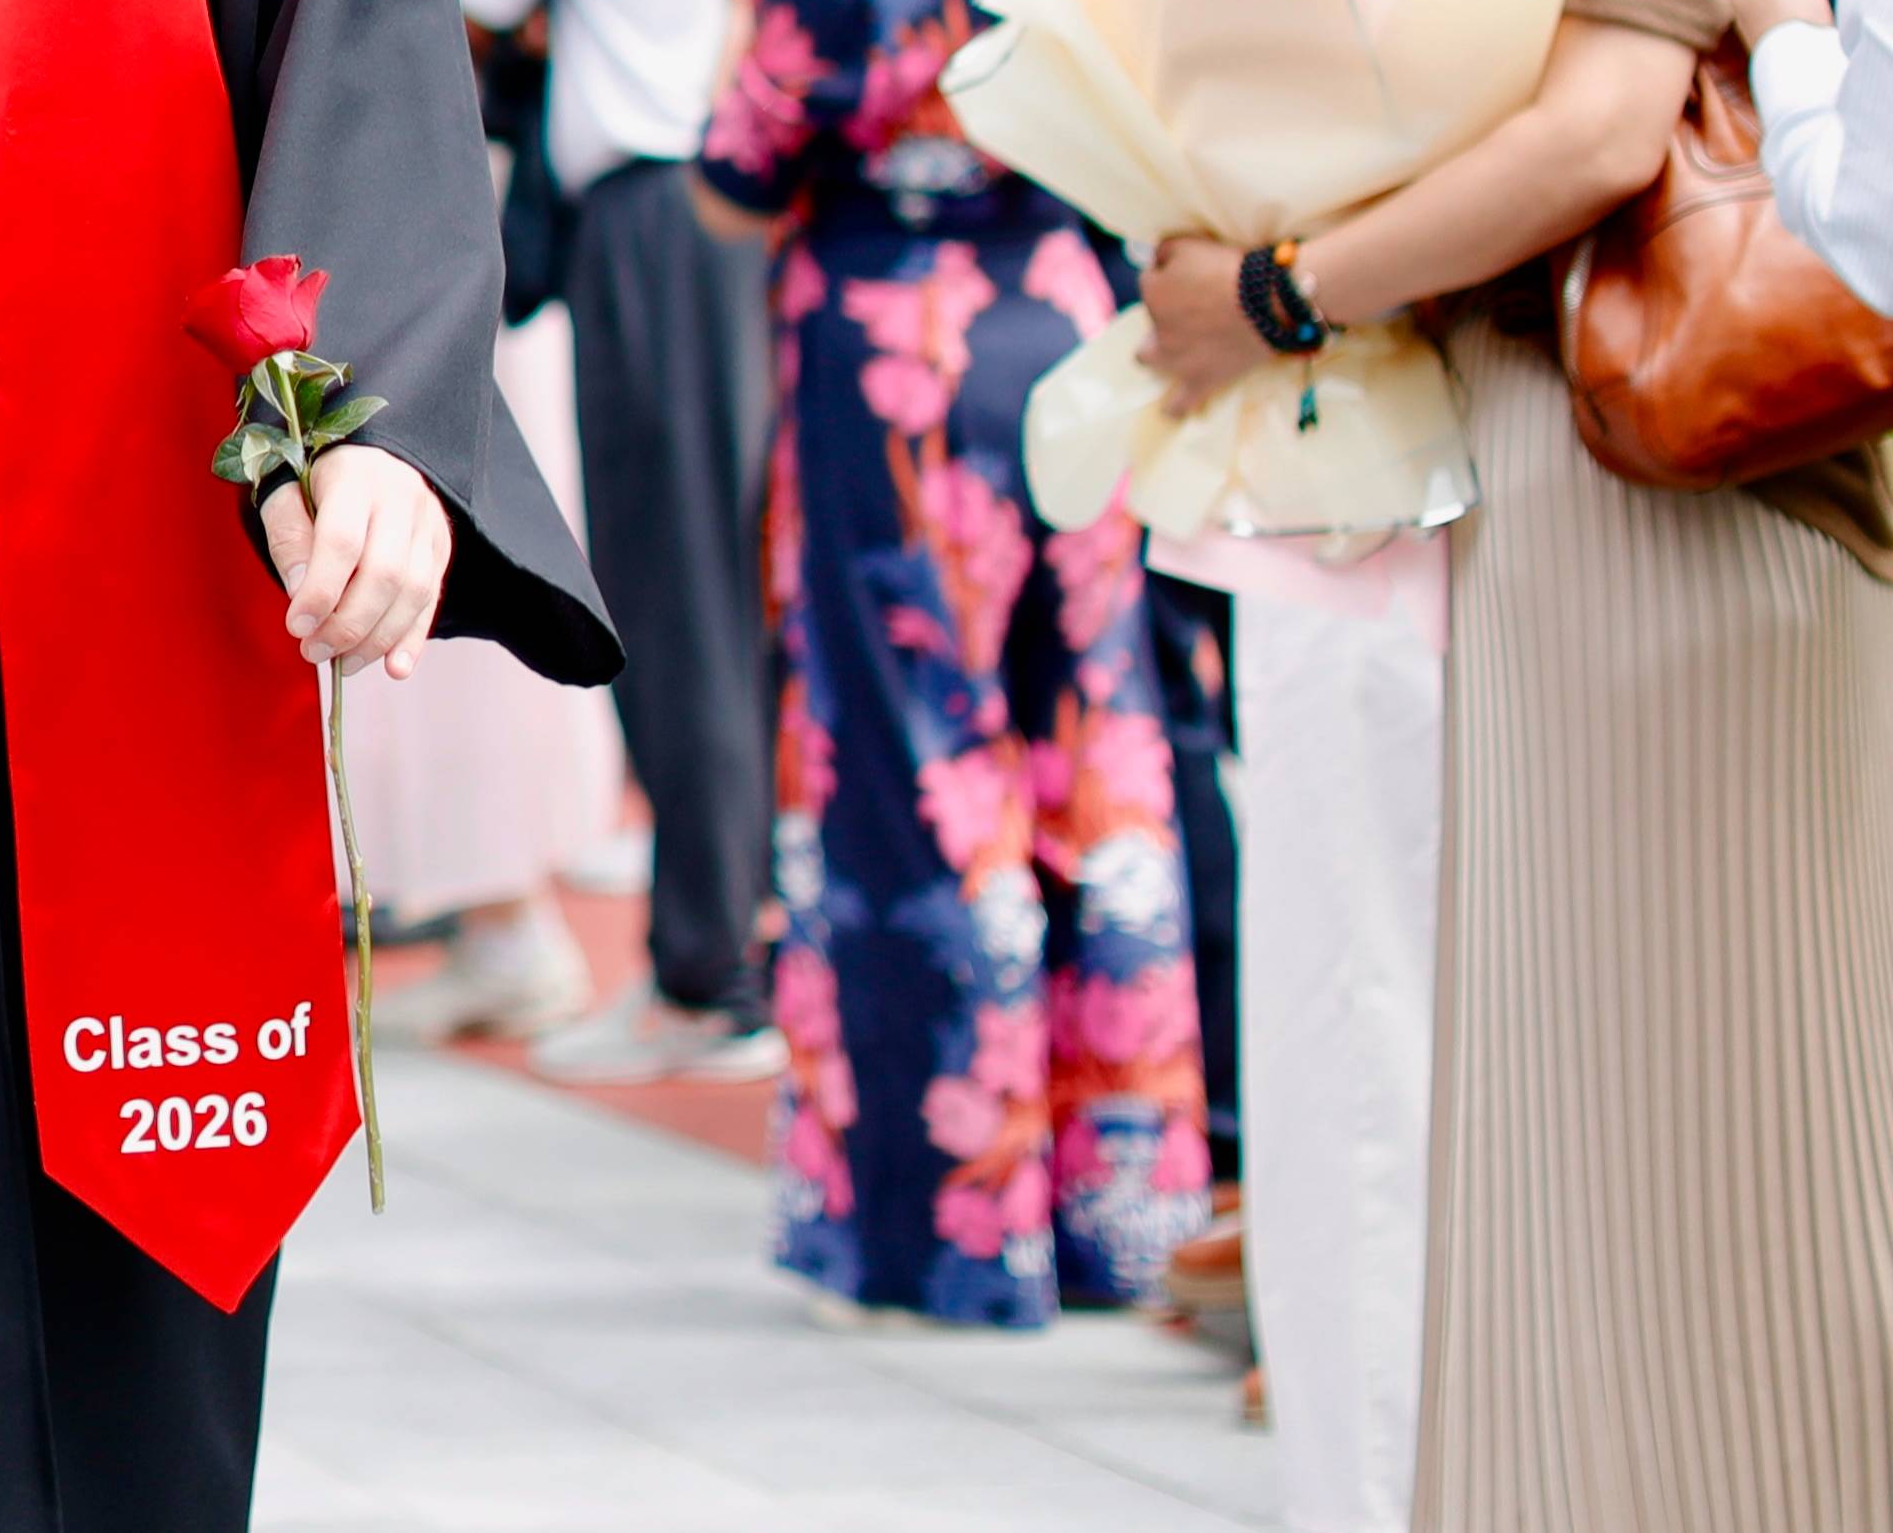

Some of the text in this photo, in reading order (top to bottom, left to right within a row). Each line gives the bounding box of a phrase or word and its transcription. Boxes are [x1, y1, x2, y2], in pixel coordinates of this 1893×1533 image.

[62, 1001, 312, 1073] Class of
[119, 1091, 269, 1154] 2026
